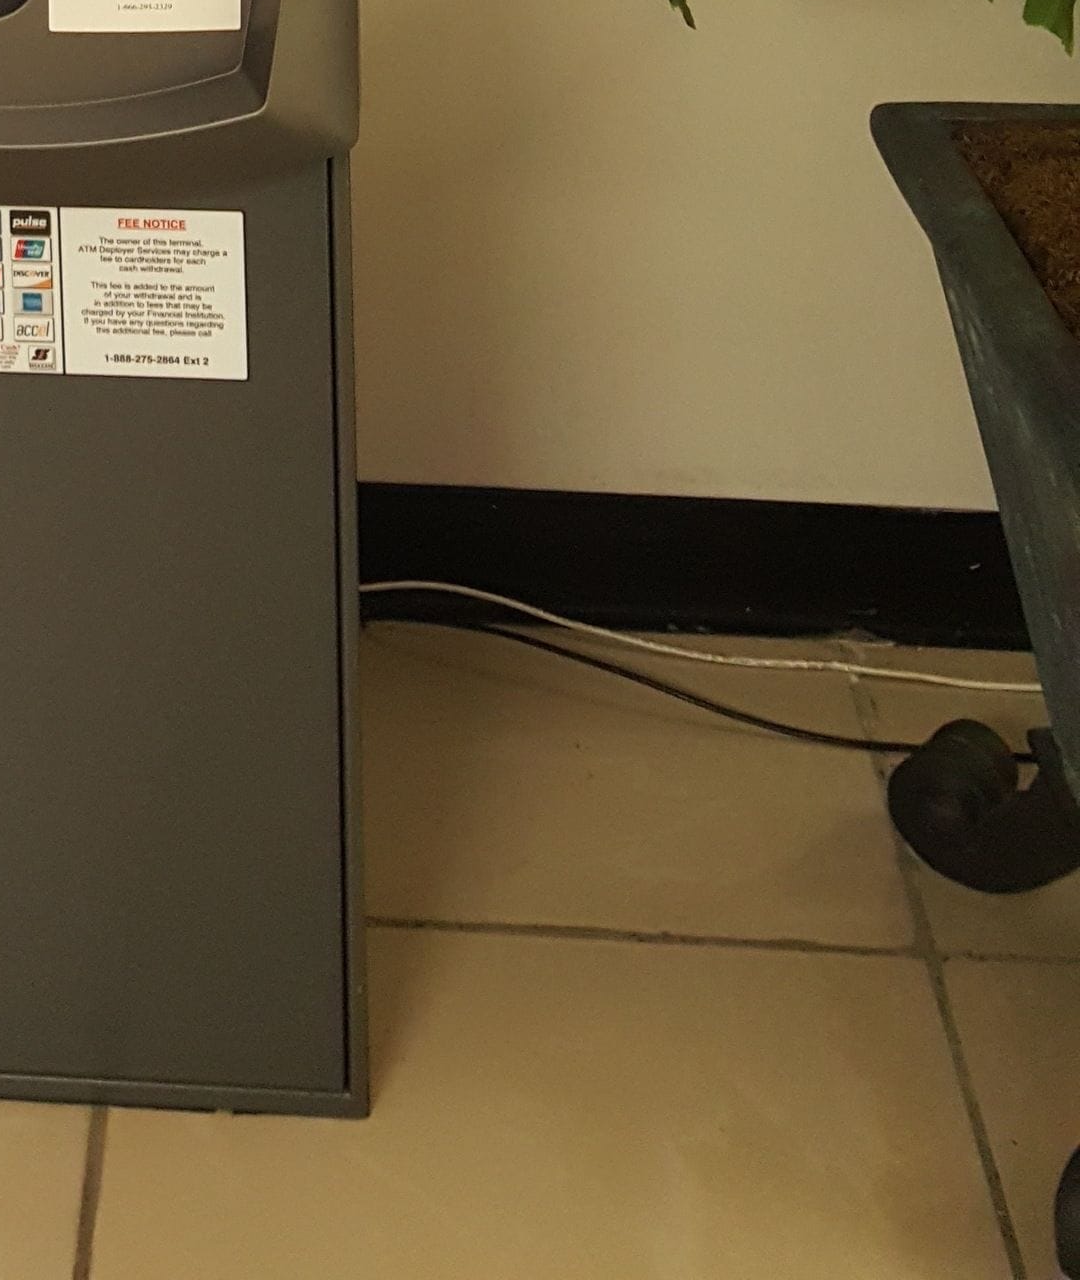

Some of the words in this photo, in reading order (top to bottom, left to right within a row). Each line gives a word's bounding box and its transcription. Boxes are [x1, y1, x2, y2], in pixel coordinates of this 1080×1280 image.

[13, 216, 47, 229] pulse
[118, 218, 140, 229] FEE
[143, 219, 186, 229] NOTICE
[99, 246, 134, 255] Deployer
[137, 247, 171, 255] Services
[173, 248, 190, 257] may
[193, 250, 220, 258] charge
[125, 256, 171, 264] cardholders
[173, 257, 184, 265] for
[13, 270, 49, 278] DISCOVER
[91, 281, 107, 289] This
[133, 282, 158, 290] added
[160, 283, 168, 291] to
[170, 283, 182, 291] the
[114, 292, 131, 300] your
[134, 292, 175, 300] withdrawal
[178, 293, 193, 301] and
[104, 300, 134, 308] addition
[147, 301, 163, 309] fees
[183, 303, 200, 311] may
[81, 309, 113, 317] charged
[116, 309, 125, 317] by
[147, 310, 183, 318] Financial
[146, 320, 184, 328] questions
[186, 321, 224, 329] regarding
[112, 327, 150, 335] additional
[170, 328, 196, 338] please
[198, 329, 212, 337] call
[184, 355, 200, 365] Ext
[203, 356, 209, 365] 2
